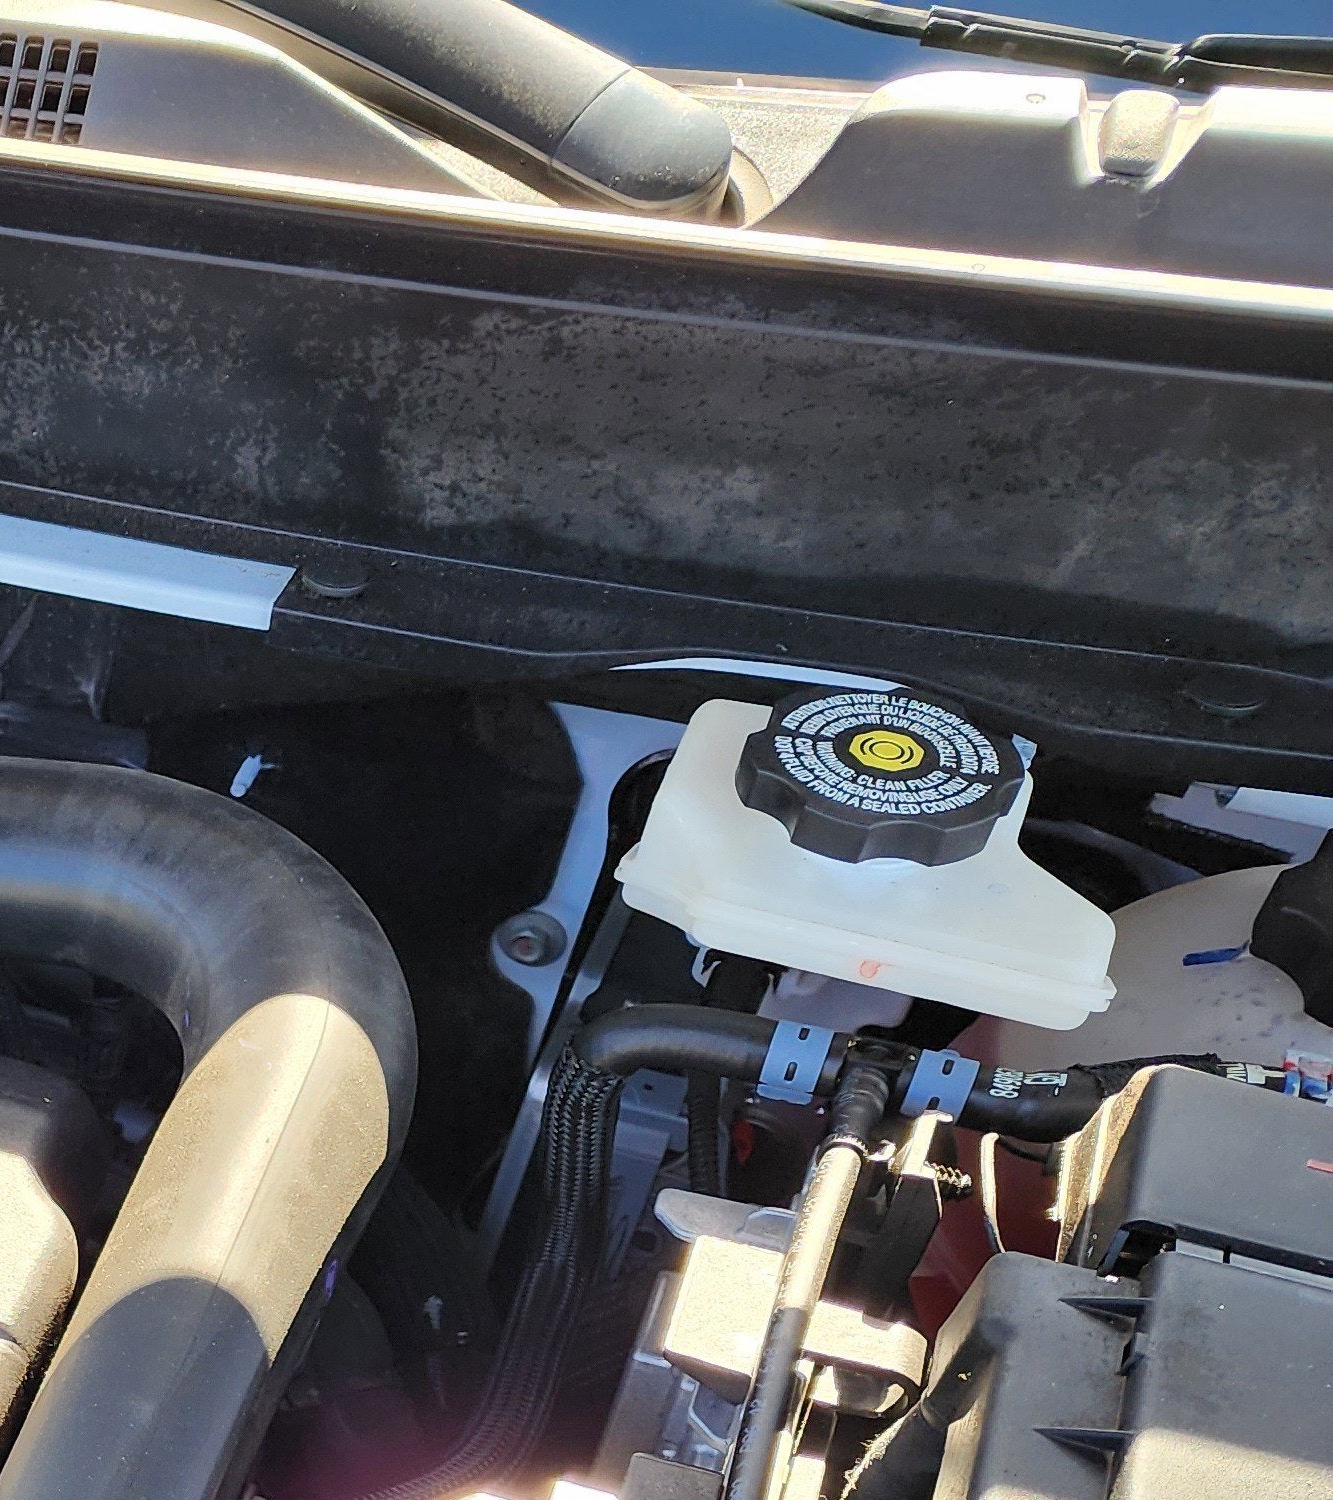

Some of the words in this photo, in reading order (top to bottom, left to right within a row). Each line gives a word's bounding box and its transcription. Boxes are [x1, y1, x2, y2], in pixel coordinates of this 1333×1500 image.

[891, 696, 908, 705] LE
[881, 705, 898, 715] DU
[937, 724, 958, 736] DE
[794, 737, 814, 754] CAP
[797, 755, 842, 785] BEFORE
[779, 759, 815, 782] FLUID
[806, 781, 850, 802] FROM
[847, 796, 861, 806] A
[861, 799, 922, 814] SEALED
[853, 774, 908, 789] CLEAN
[906, 770, 952, 789] FILLER
[935, 778, 970, 795] ONLY
[913, 789, 944, 801] USE
